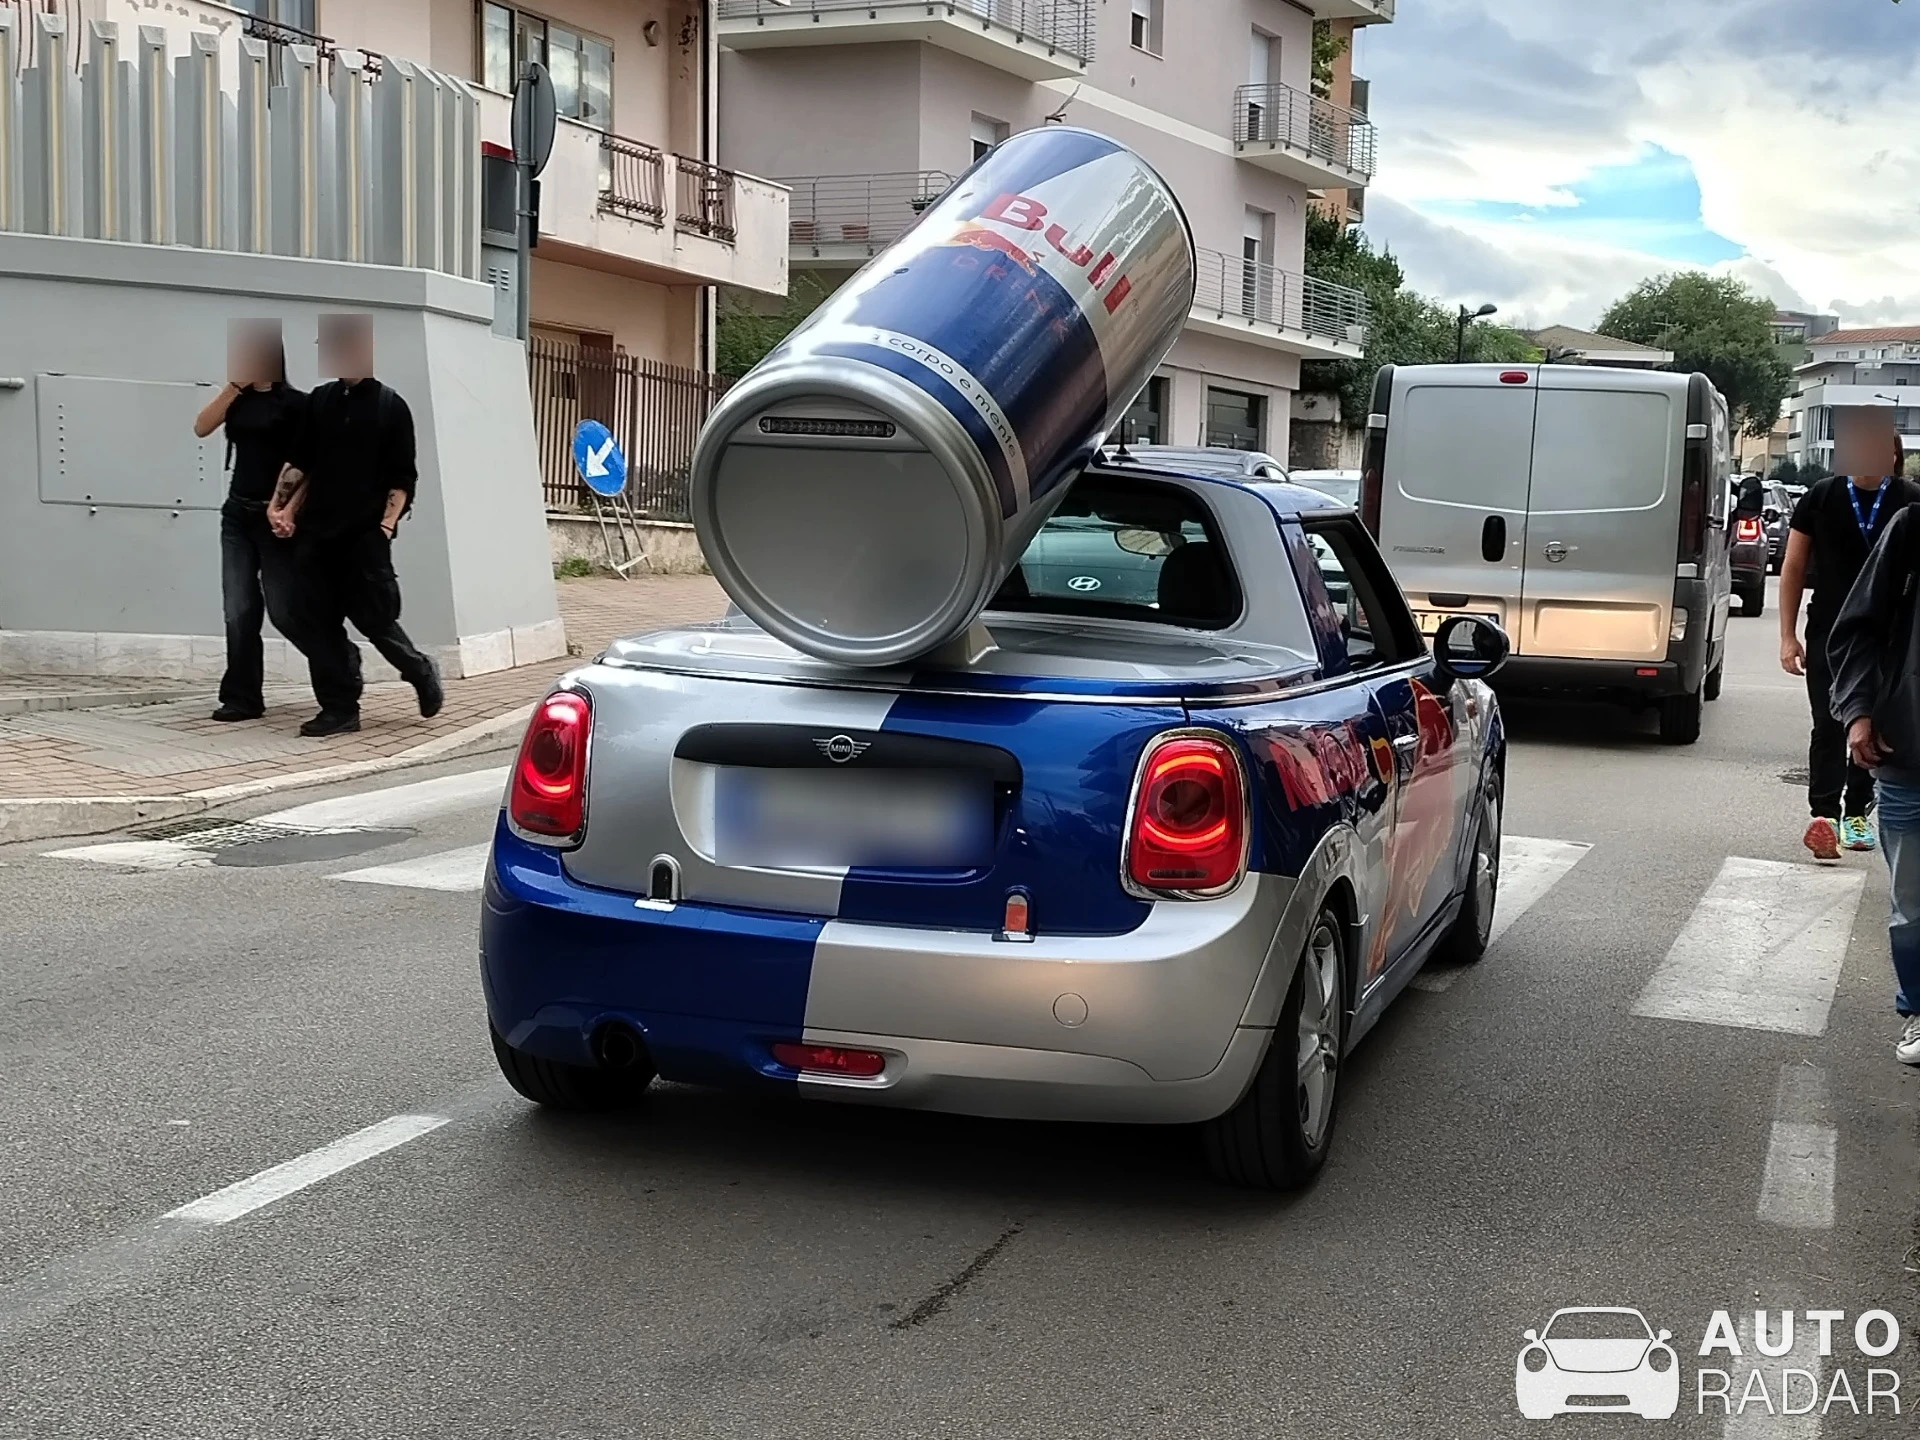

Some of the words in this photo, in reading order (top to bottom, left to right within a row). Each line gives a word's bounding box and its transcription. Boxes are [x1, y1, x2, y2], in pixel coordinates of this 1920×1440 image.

[979, 193, 1132, 316] Bull
[888, 337, 954, 375] corpo
[959, 378, 971, 390] e
[831, 744, 851, 753] MINI
